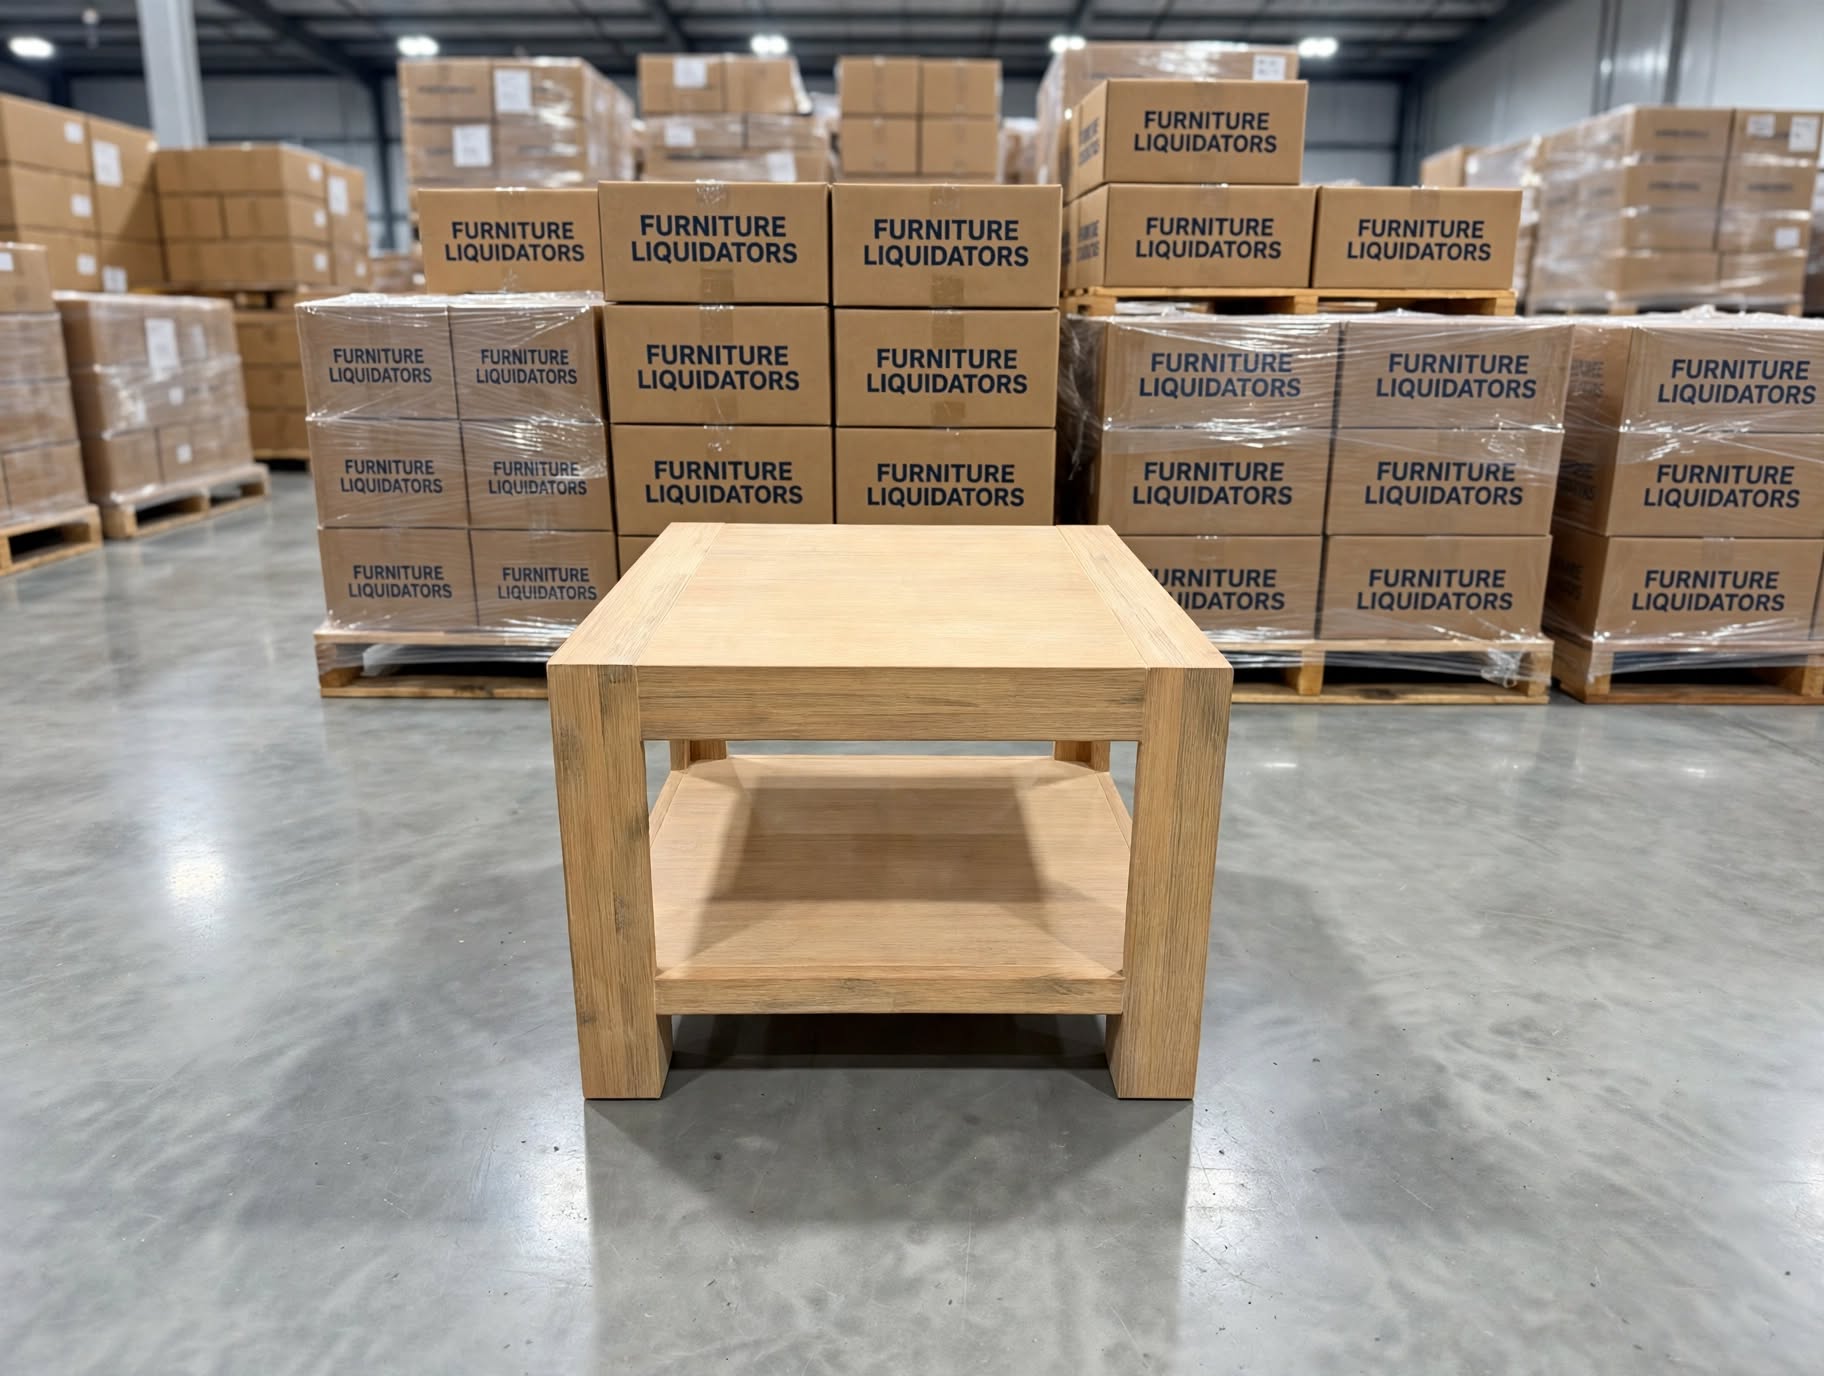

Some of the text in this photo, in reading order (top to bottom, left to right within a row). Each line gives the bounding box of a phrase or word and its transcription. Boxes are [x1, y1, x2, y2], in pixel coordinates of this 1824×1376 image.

[1145, 111, 1269, 130] FURNITURE
[1134, 134, 1277, 153] LIQUIDATORS
[452, 222, 574, 239] FURNITURE
[641, 215, 786, 237] FURNITURE
[874, 219, 1018, 240] FURNITURE
[1146, 217, 1274, 236] FURNITURE
[1359, 219, 1484, 239] FURNITURE
[445, 244, 584, 262] LIQUIDATORS
[632, 241, 797, 263] LIQUIDATORS
[864, 245, 1028, 267] LIQUIDATORS
[1136, 240, 1281, 259] LIQUIDATORS
[1347, 242, 1491, 261] LIQUIDATORS
[333, 348, 424, 364] FURNITURE
[481, 349, 568, 365] FURNITURE
[647, 344, 788, 365] FURNITURE
[877, 349, 1017, 369] FURNITURE
[1151, 353, 1293, 373] FURNITURE
[1389, 353, 1529, 374] FURNITURE
[329, 367, 432, 384] LIQUIDATORS
[477, 369, 577, 384] LIQUIDATORS
[1672, 359, 1810, 380] FURNITURE
[638, 370, 799, 391] LIQUIDATORS
[867, 373, 1027, 394] LIQUIDATORS
[1139, 377, 1300, 399] LIQUIDATORS
[1377, 378, 1536, 399] LIQUIDATORS
[1658, 384, 1816, 404] LIQUIDATORS
[345, 459, 434, 475] FURNITURE
[493, 461, 578, 476] FURNITURE
[655, 461, 792, 480] FURNITURE
[878, 464, 1014, 483] FURNITURE
[1145, 462, 1284, 481] FURNITURE
[1377, 462, 1515, 482] FURNITURE
[1657, 464, 1794, 485] FURNITURE
[341, 478, 443, 493] LIQUIDATORS
[488, 480, 587, 495] LIQUIDATORS
[646, 485, 803, 504] LIQUIDATORS
[868, 487, 1024, 507] LIQUIDATORS
[1133, 486, 1292, 506] LIQUIDATORS
[1365, 486, 1523, 506] LIQUIDATORS
[1644, 488, 1800, 508] LIQUIDATORS
[353, 565, 443, 580] FURNITURE
[503, 567, 589, 582] FURNITURE
[1149, 569, 1276, 587] URNITURE
[1369, 569, 1505, 588] FURNITURE
[1645, 570, 1779, 589] FURNITURE
[349, 583, 452, 598] LIQUIDATORS
[498, 585, 597, 600] LIQUIDATORS
[1357, 592, 1512, 611] LIQUIDATORS
[1632, 593, 1784, 612] LIQUIDATORS
